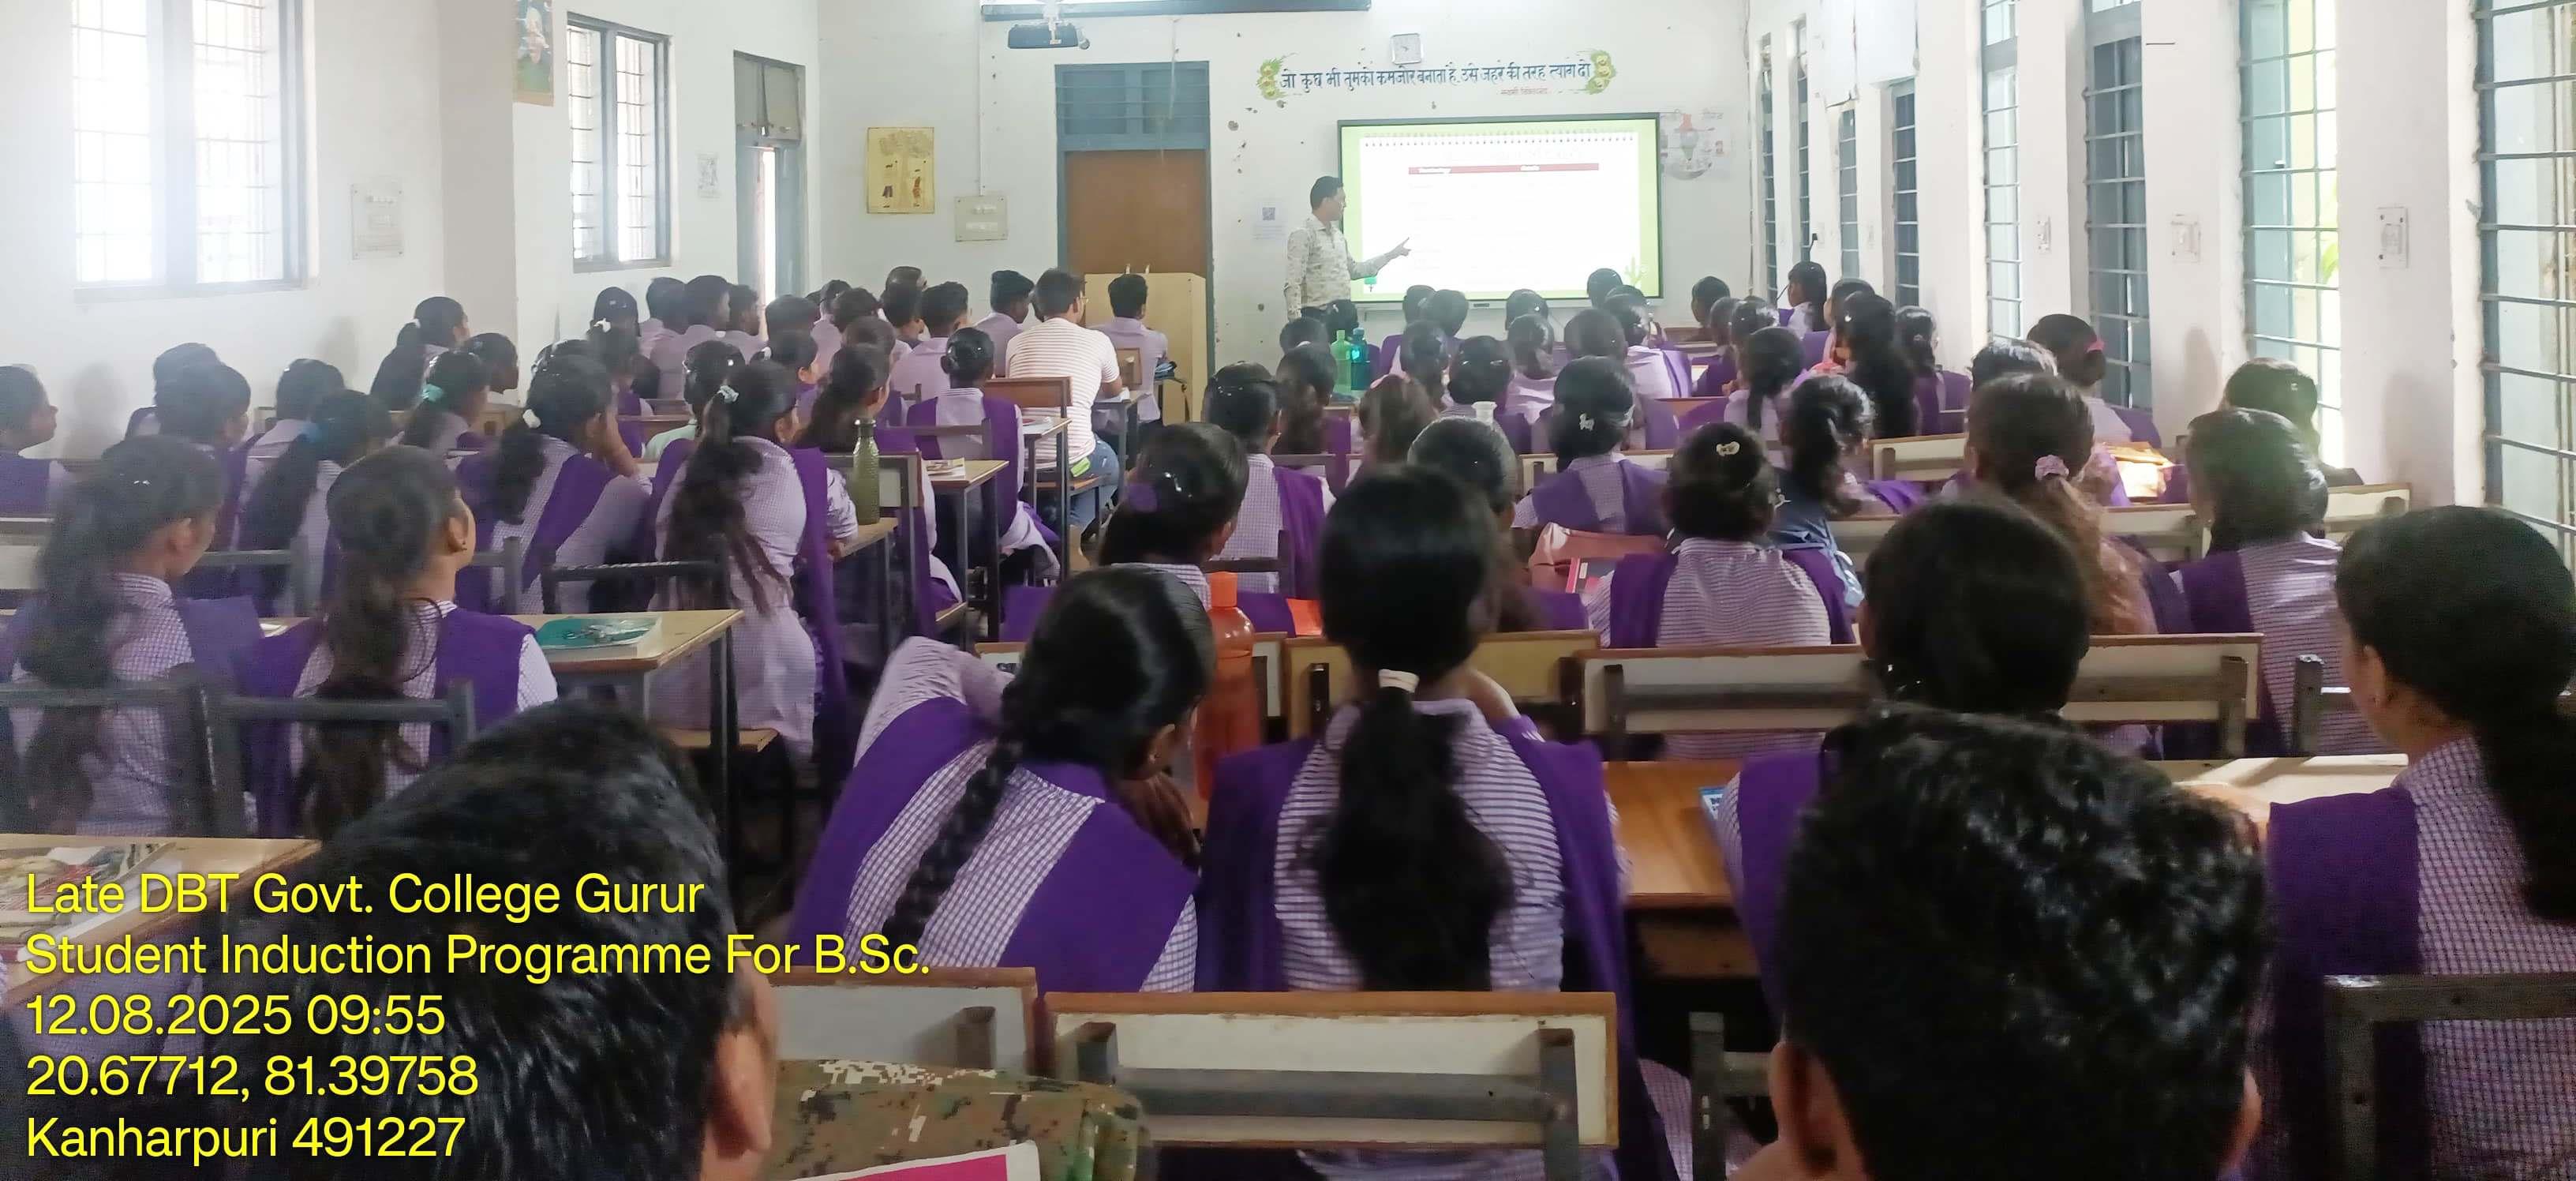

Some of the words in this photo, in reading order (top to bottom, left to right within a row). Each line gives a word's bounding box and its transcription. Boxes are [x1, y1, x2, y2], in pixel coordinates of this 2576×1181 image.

[1280, 69, 1296, 88] जो
[1326, 67, 1341, 87] भी
[1417, 69, 1446, 84] बनाता
[1461, 63, 1479, 82] उसे
[1507, 62, 1520, 79] की
[1523, 65, 1546, 81] तरह
[1549, 63, 1576, 79] त्याग
[1578, 59, 1591, 77] दो
